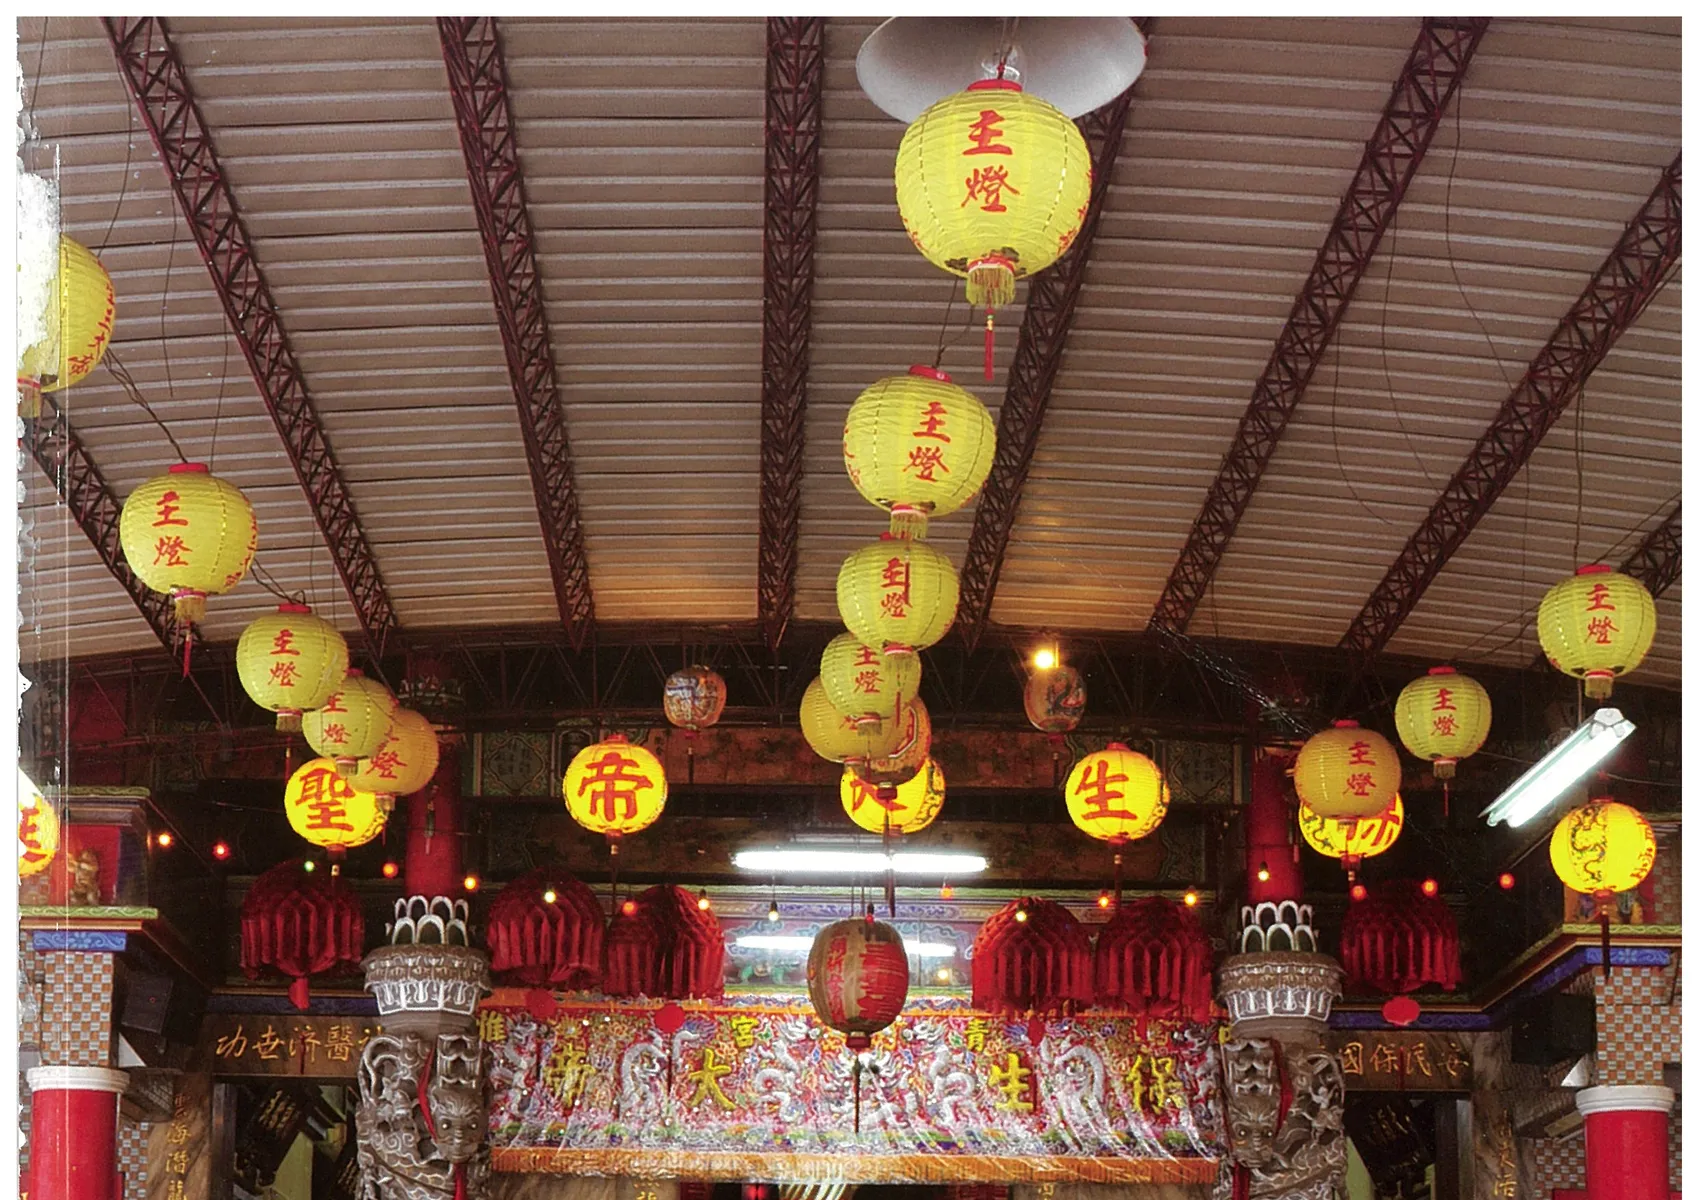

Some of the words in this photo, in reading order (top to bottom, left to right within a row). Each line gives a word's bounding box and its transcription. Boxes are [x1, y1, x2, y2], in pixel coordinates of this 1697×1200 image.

[962, 109, 1020, 213] 主燈
[902, 401, 951, 482] 主燈
[152, 491, 193, 567] 主燈
[880, 556, 913, 619] 主燈
[1584, 583, 1620, 645] 主燈
[268, 629, 302, 687] 主燈
[1430, 687, 1460, 737] 主燈
[366, 725, 408, 780] 燈
[1343, 741, 1377, 797] 主燈
[295, 769, 355, 833] 聖
[577, 751, 655, 822] 帝
[1074, 759, 1139, 821] 生
